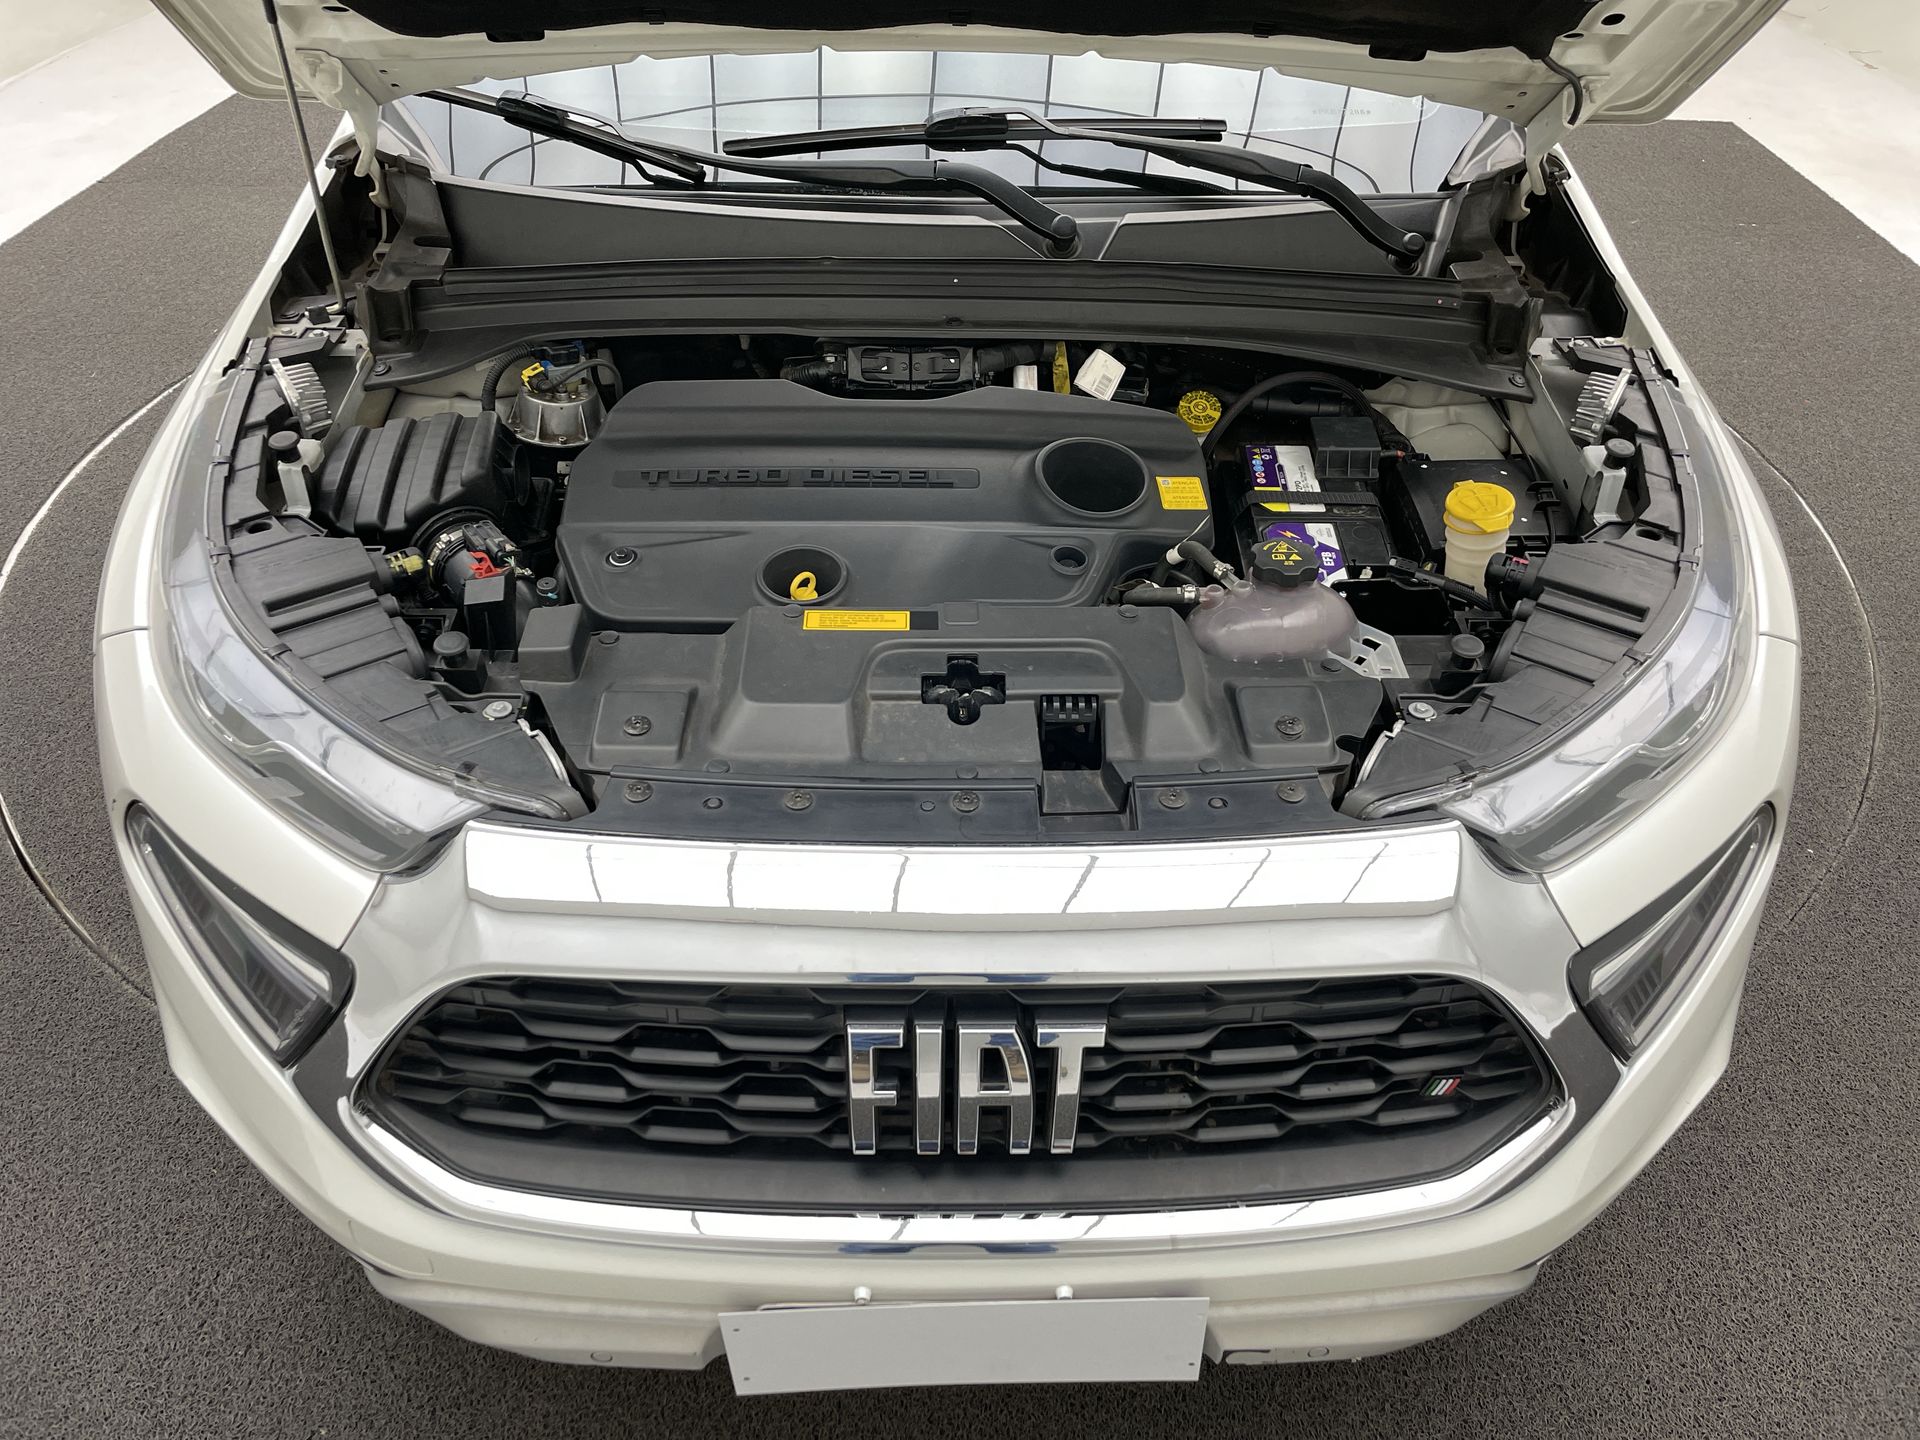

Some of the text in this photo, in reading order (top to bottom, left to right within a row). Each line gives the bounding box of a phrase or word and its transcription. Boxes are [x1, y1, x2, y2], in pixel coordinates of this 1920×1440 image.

[641, 467, 954, 488] TURBO DIESEL
[1321, 551, 1335, 567] EFB
[847, 1024, 1106, 1155] FIAT
